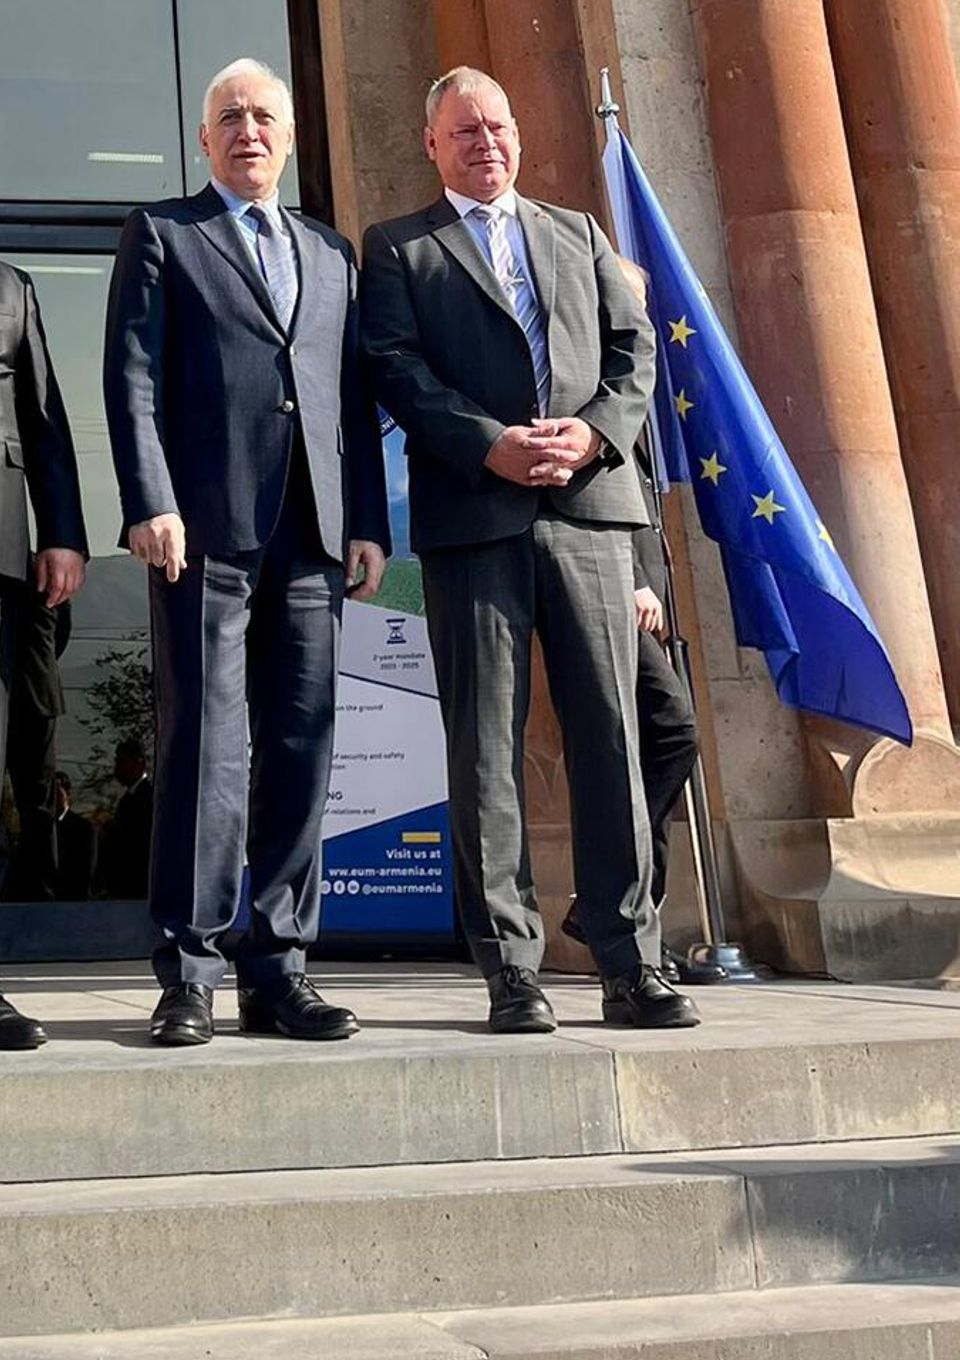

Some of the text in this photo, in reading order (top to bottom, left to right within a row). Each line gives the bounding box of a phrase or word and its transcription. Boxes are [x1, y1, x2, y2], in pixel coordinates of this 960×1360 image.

[385, 848, 441, 859] Visit us at
[362, 882, 443, 896] @eumarmenia
